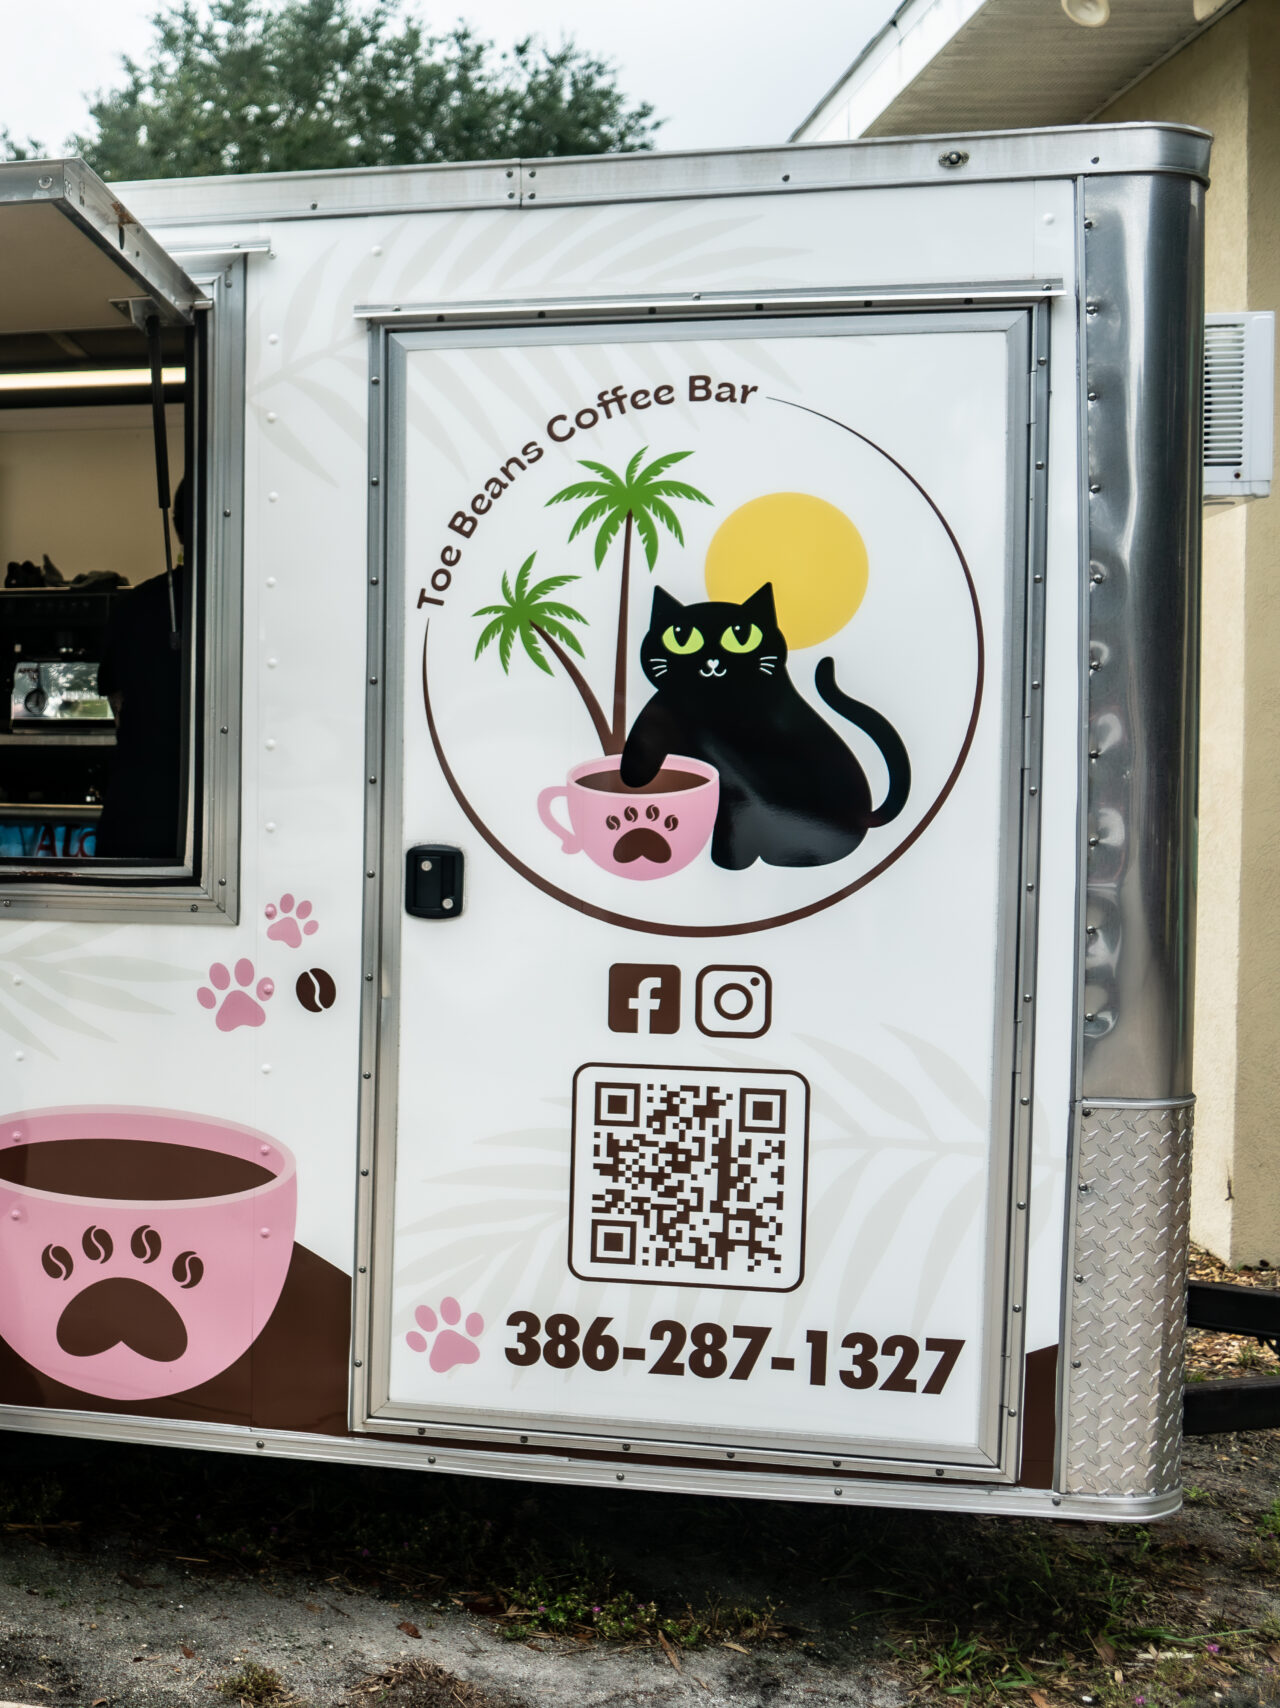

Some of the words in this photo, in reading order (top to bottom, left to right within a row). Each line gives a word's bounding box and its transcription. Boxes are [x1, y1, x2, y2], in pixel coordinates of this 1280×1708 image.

[417, 545, 461, 609] Toe
[448, 441, 544, 539] Beans
[547, 384, 675, 442] Coffee
[688, 375, 759, 405] Bar
[504, 1310, 965, 1395] 386-287-1327
